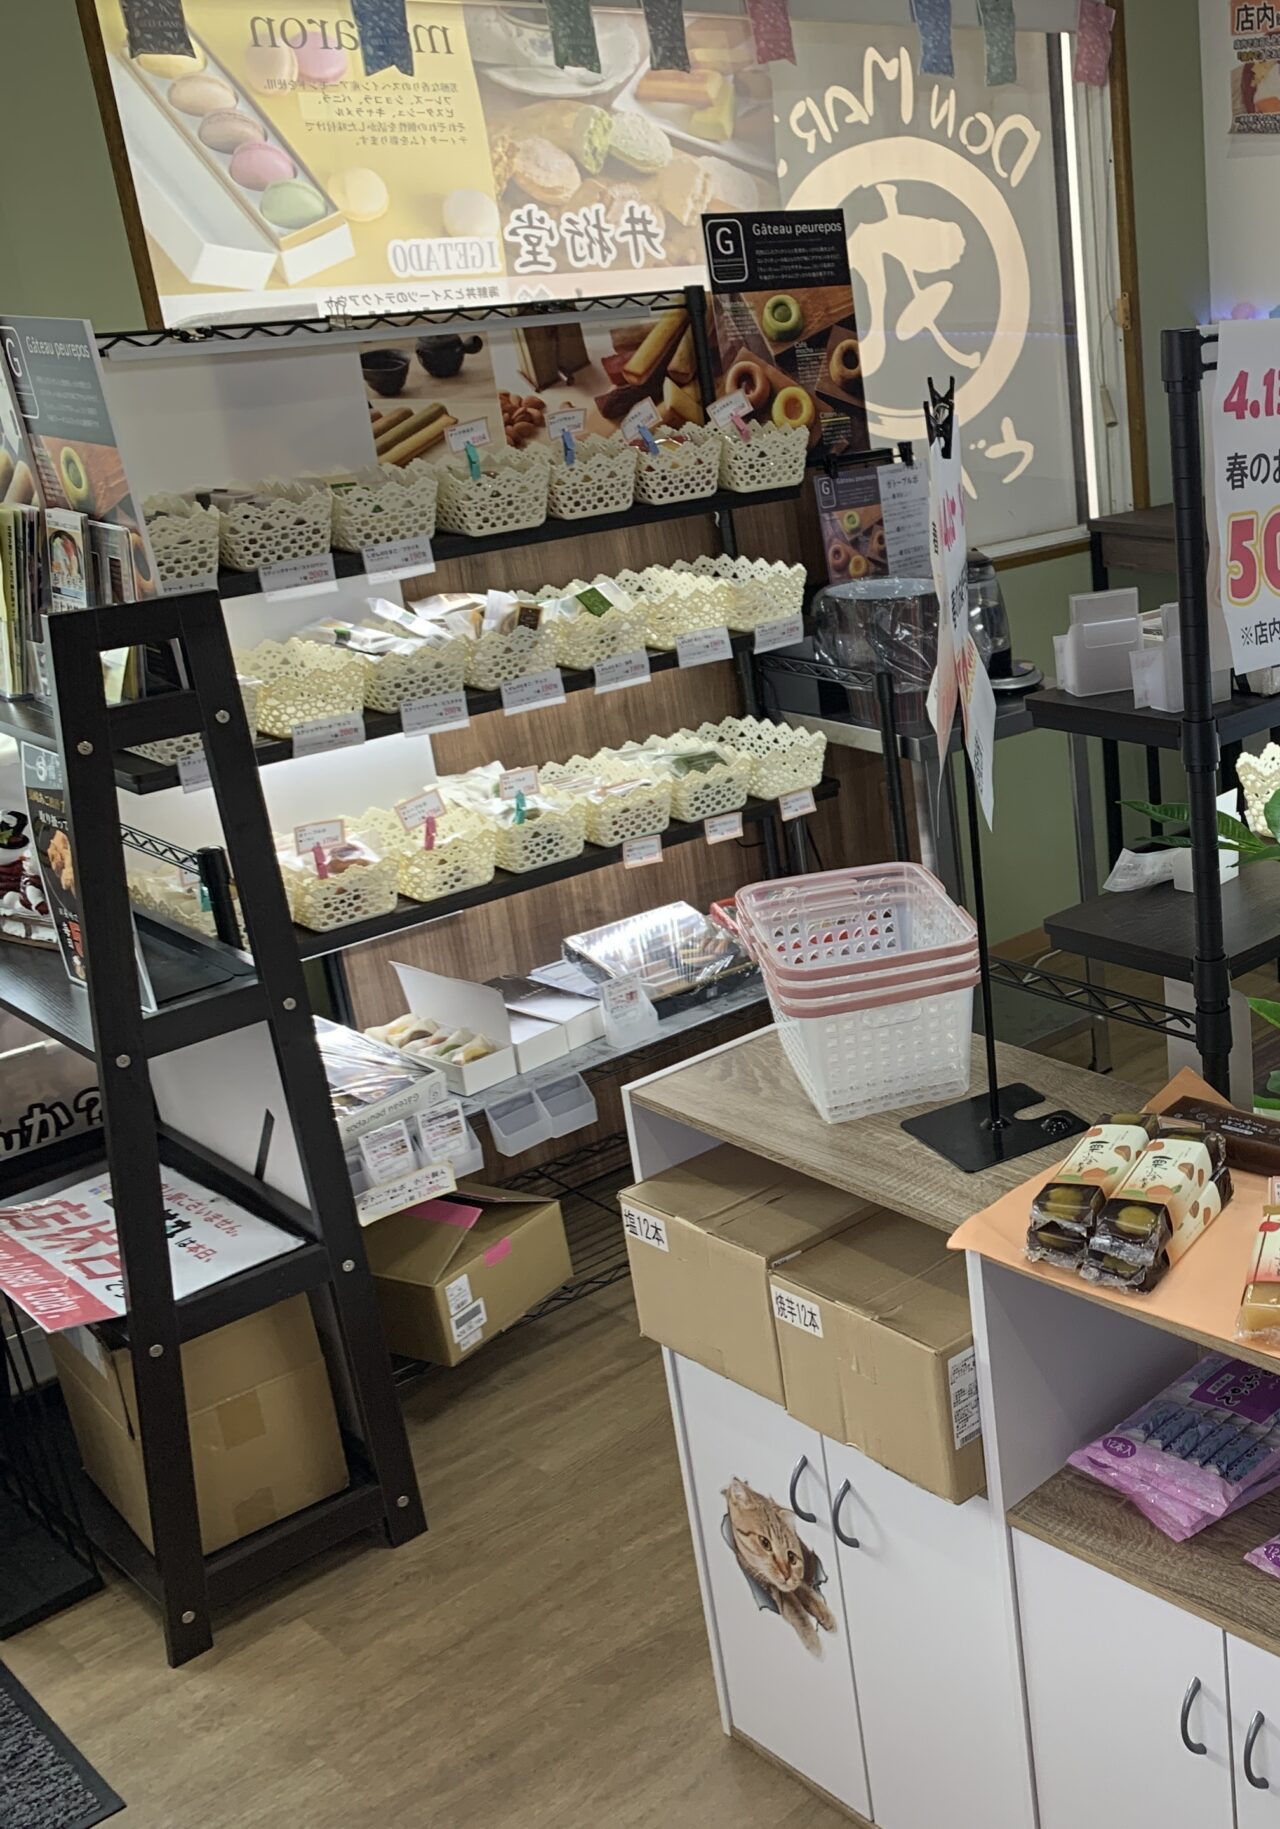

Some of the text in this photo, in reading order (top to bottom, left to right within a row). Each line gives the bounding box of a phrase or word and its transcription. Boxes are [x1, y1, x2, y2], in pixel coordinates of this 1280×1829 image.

[715, 220, 843, 255] G Gâteau peurepos
[6, 335, 90, 378] G Gâteau peurepos
[624, 1207, 665, 1246] 塩12本
[174, 1236, 218, 1263] は本日、
[774, 1292, 820, 1333] 焼芋12本
[1104, 1437, 1134, 1458] 12本入
